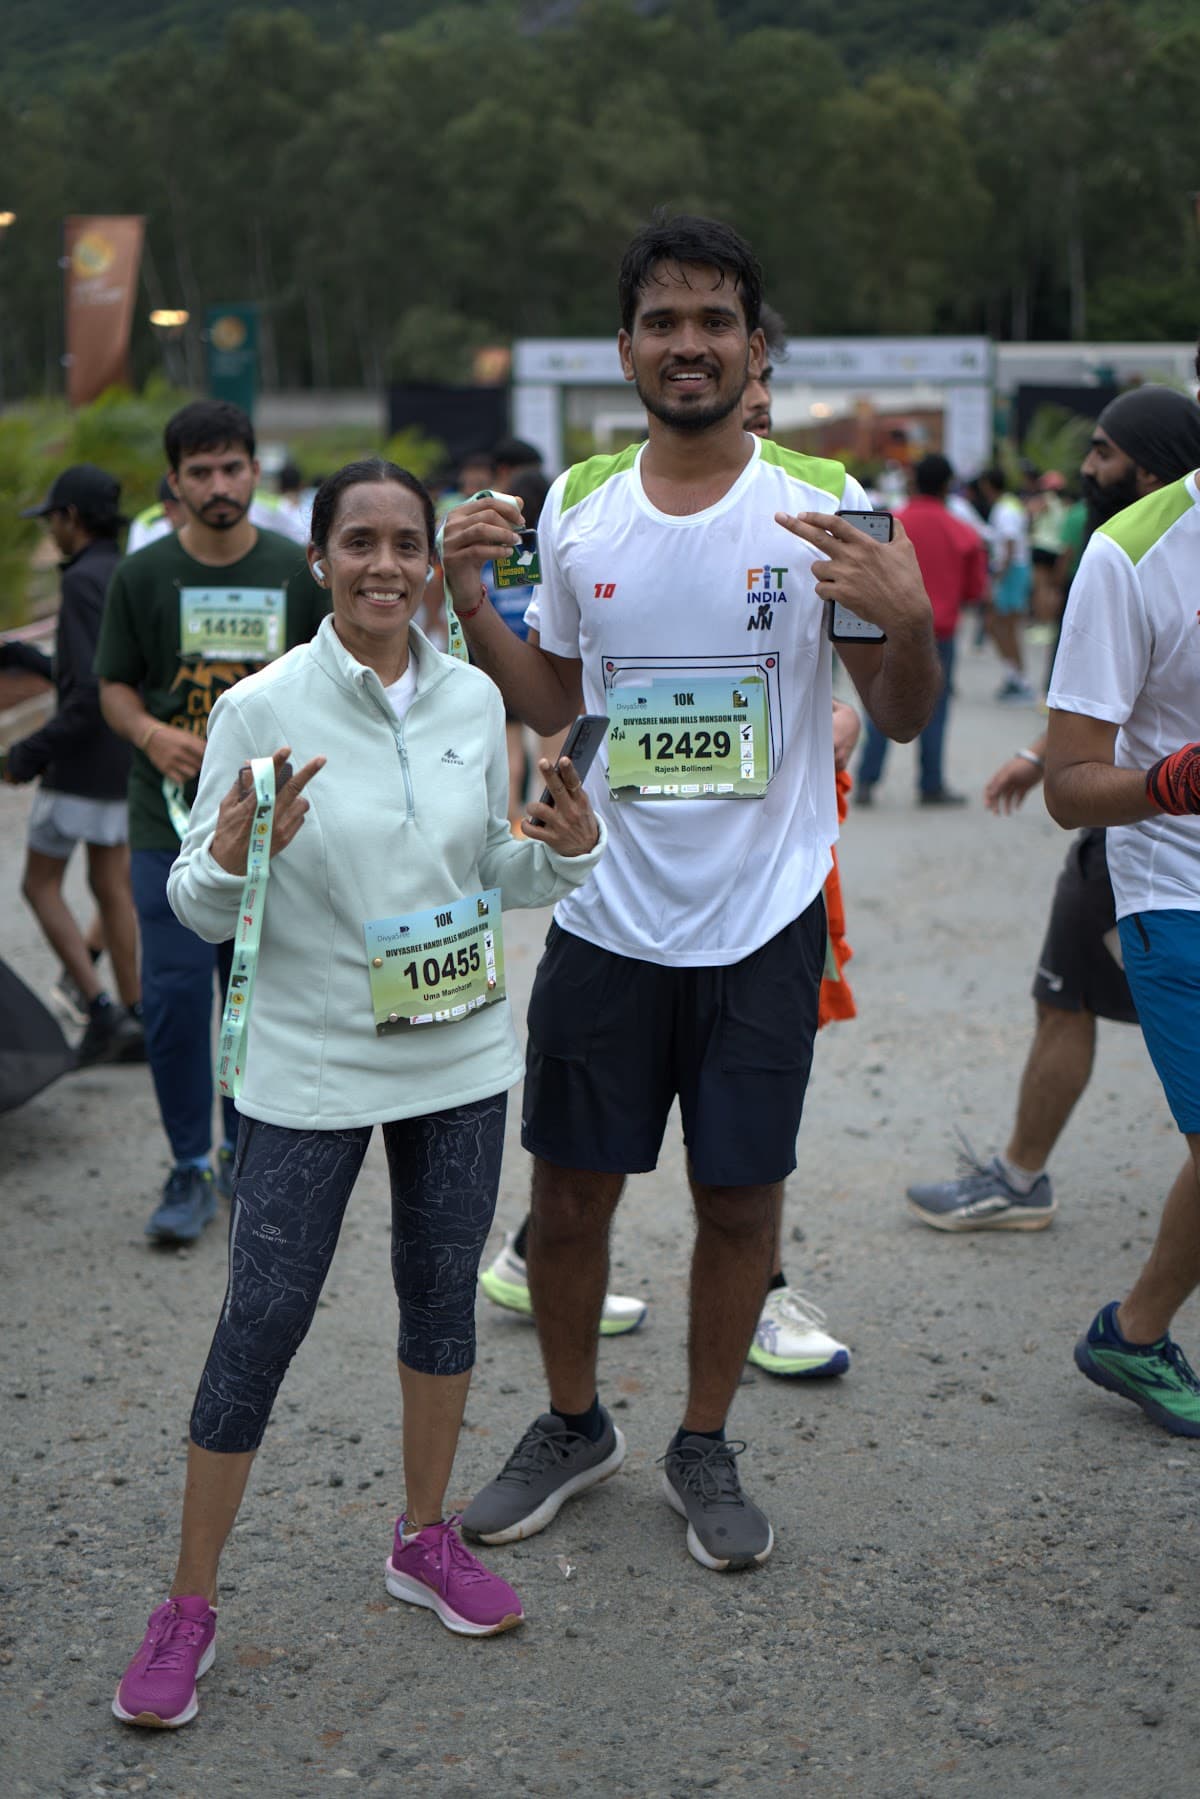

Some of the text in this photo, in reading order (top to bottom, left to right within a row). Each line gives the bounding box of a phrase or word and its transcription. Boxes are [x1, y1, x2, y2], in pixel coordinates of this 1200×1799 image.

[747, 591, 788, 604] INDIA
[203, 617, 264, 636] 14120
[672, 692, 695, 706] 10K
[623, 714, 747, 725] DIVYASREE NANDI HILLS MONSOON RUN
[638, 731, 731, 760] 12429
[655, 765, 680, 774] Rajesh
[434, 911, 453, 928] 10K
[377, 932, 410, 943] DivyaSree
[386, 943, 422, 958] DIVYASREE
[423, 939, 442, 951] NANDI
[443, 934, 458, 946] HILLS
[458, 925, 479, 941] MONSOON
[403, 942, 481, 990] 10455
[423, 993, 440, 1001] Uma
